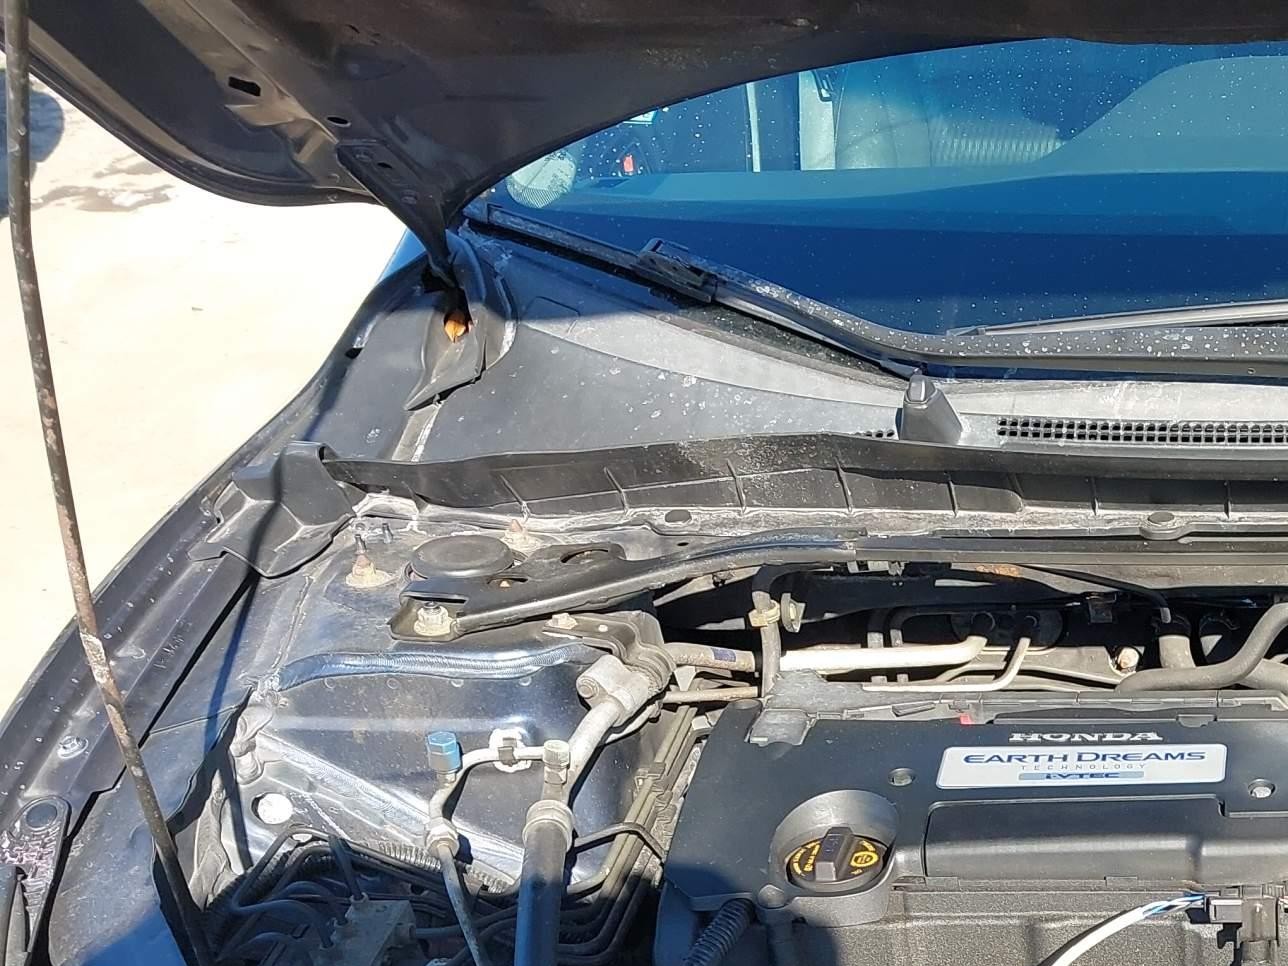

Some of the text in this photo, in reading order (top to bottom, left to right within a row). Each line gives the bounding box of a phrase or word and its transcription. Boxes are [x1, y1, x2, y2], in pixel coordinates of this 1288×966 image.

[1008, 732, 1163, 742] HONDA
[963, 751, 1206, 763] EARTH DREAMS
[1045, 772, 1121, 780] i-VTEC
